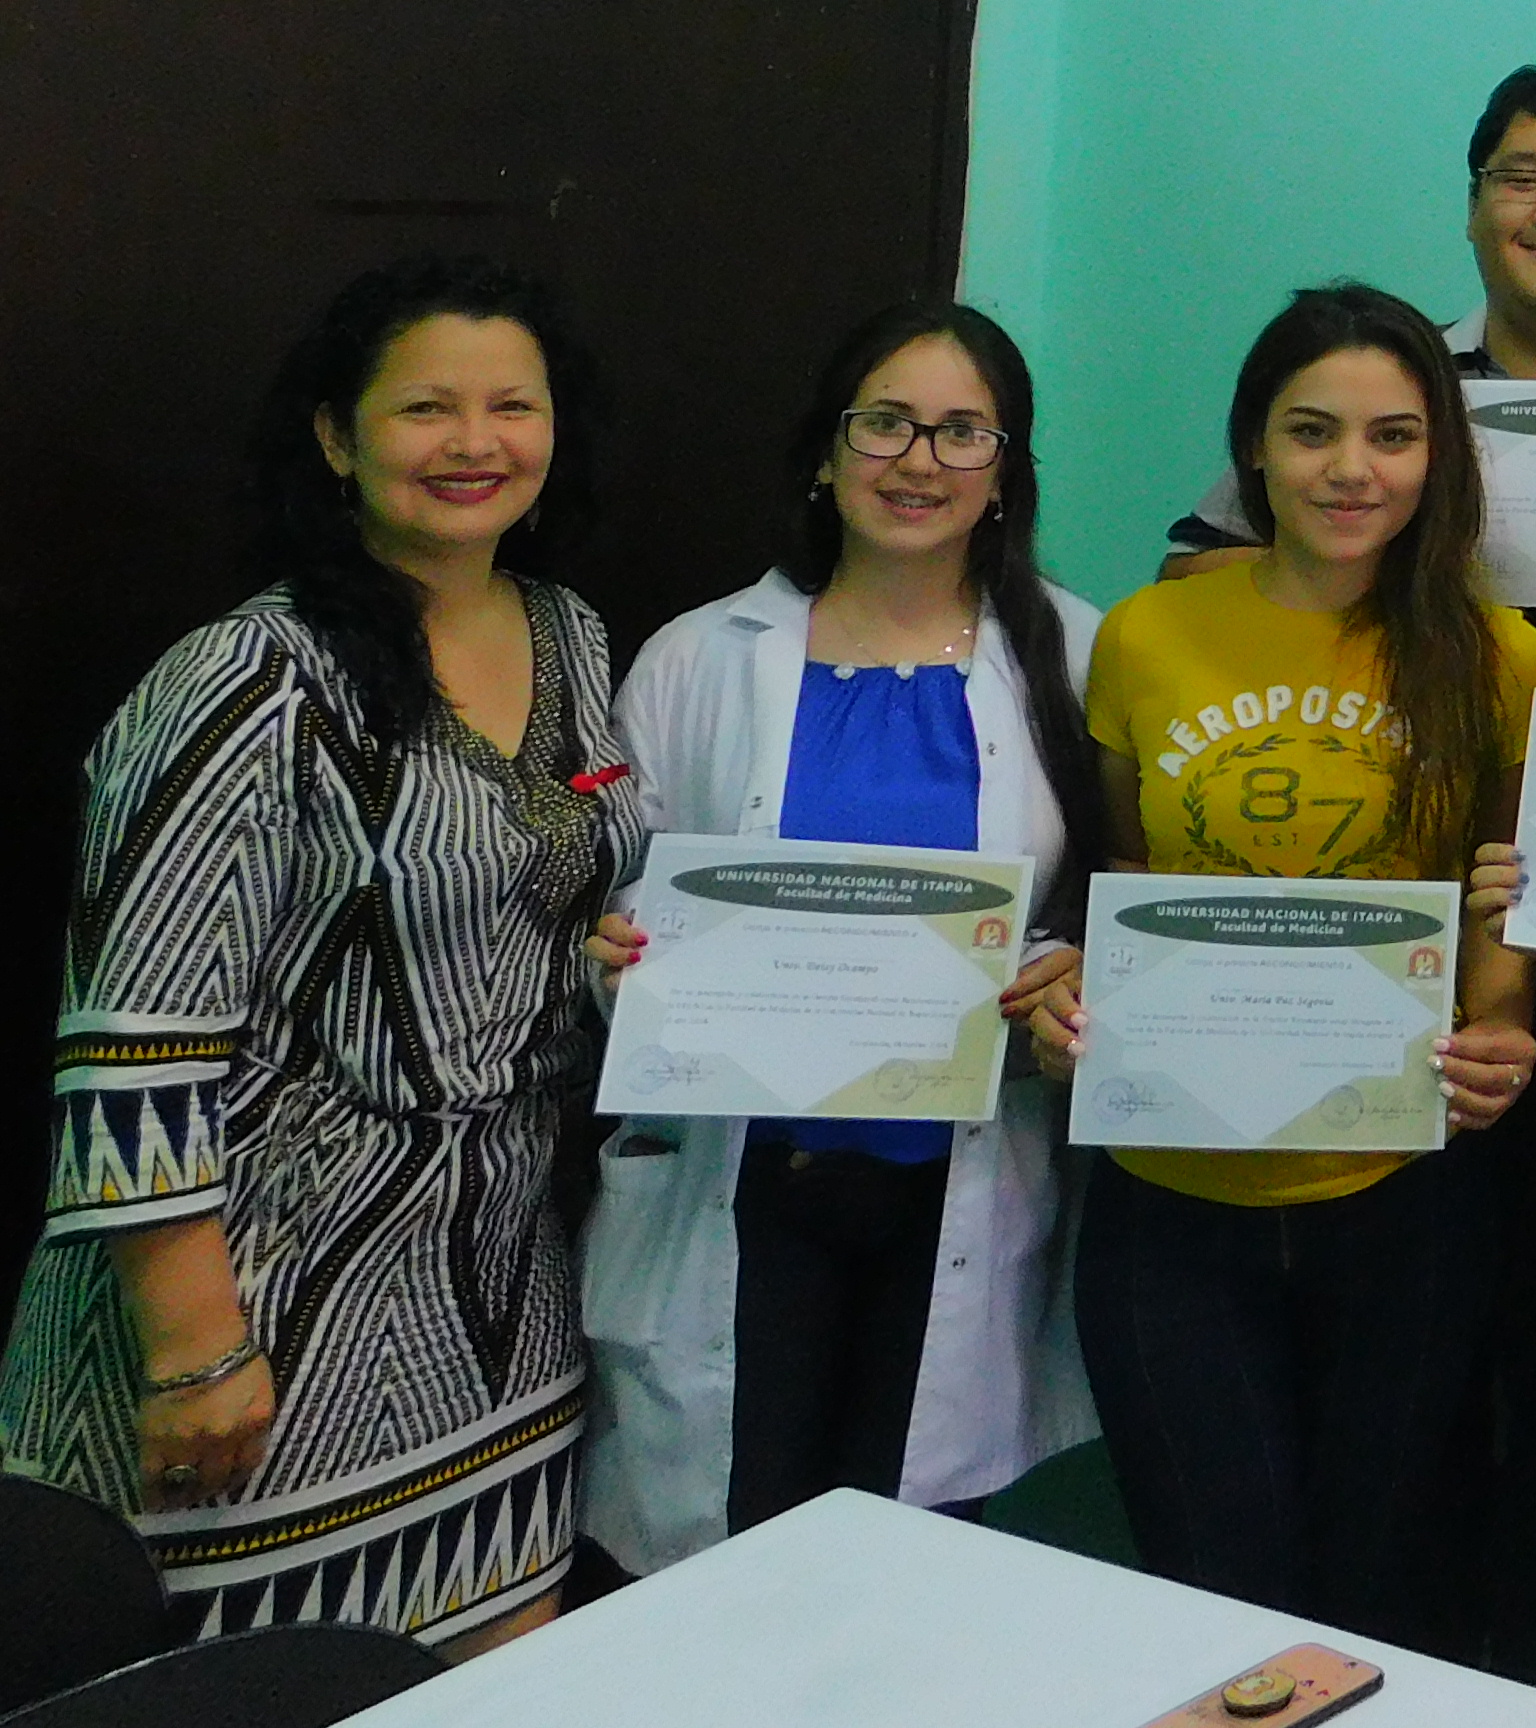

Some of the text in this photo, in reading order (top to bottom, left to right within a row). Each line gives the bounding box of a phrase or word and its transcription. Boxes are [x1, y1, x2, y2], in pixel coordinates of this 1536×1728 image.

[715, 870, 974, 894] UNIVERSIDAD NACIONAL DE ITAPÚA
[774, 885, 913, 904] Facultad de Medicina
[1156, 905, 1403, 924] UNIVERSIDAD NACIONAL DE ITAPÚA
[1213, 920, 1344, 936] Facultad de Medicina
